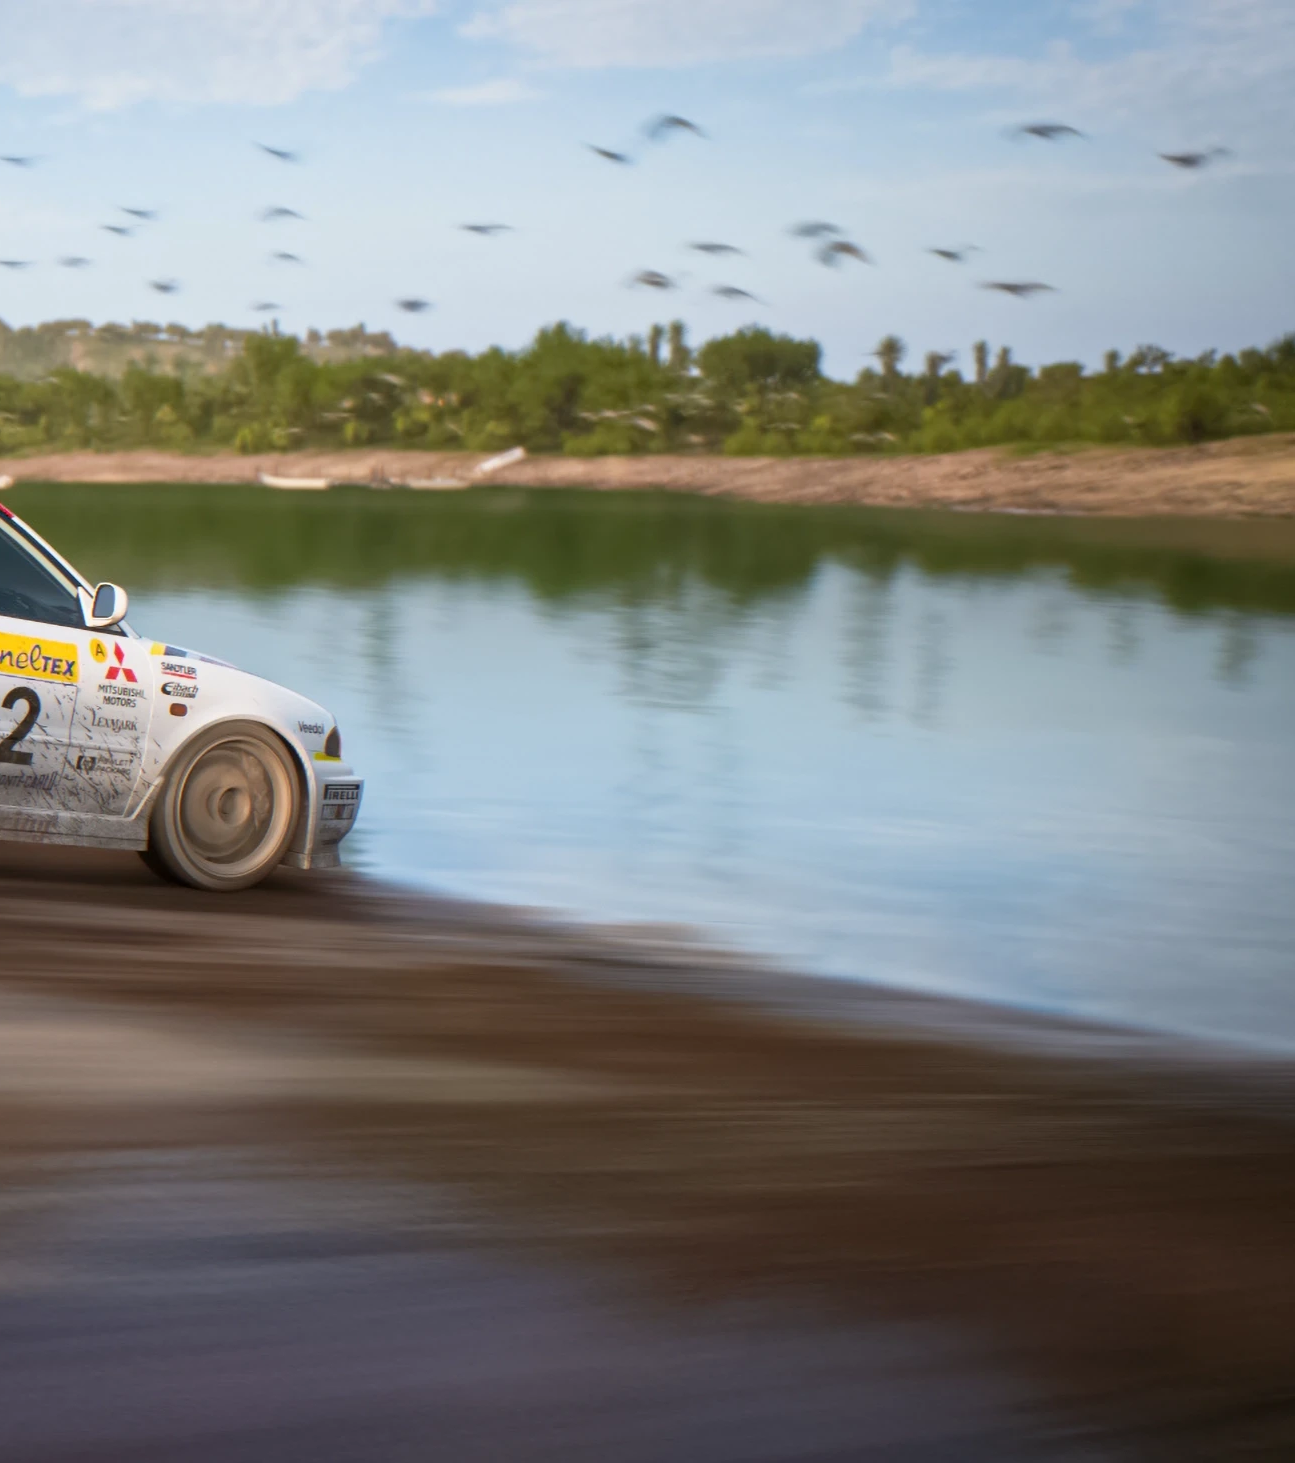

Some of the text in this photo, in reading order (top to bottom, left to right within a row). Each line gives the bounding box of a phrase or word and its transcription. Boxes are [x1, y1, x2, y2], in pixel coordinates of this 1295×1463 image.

[94, 643, 106, 657] A
[97, 684, 144, 697] MITSUBISHI
[102, 695, 137, 708] MOTORS
[298, 720, 325, 735] Veedol
[323, 784, 360, 800] PIRELLI
